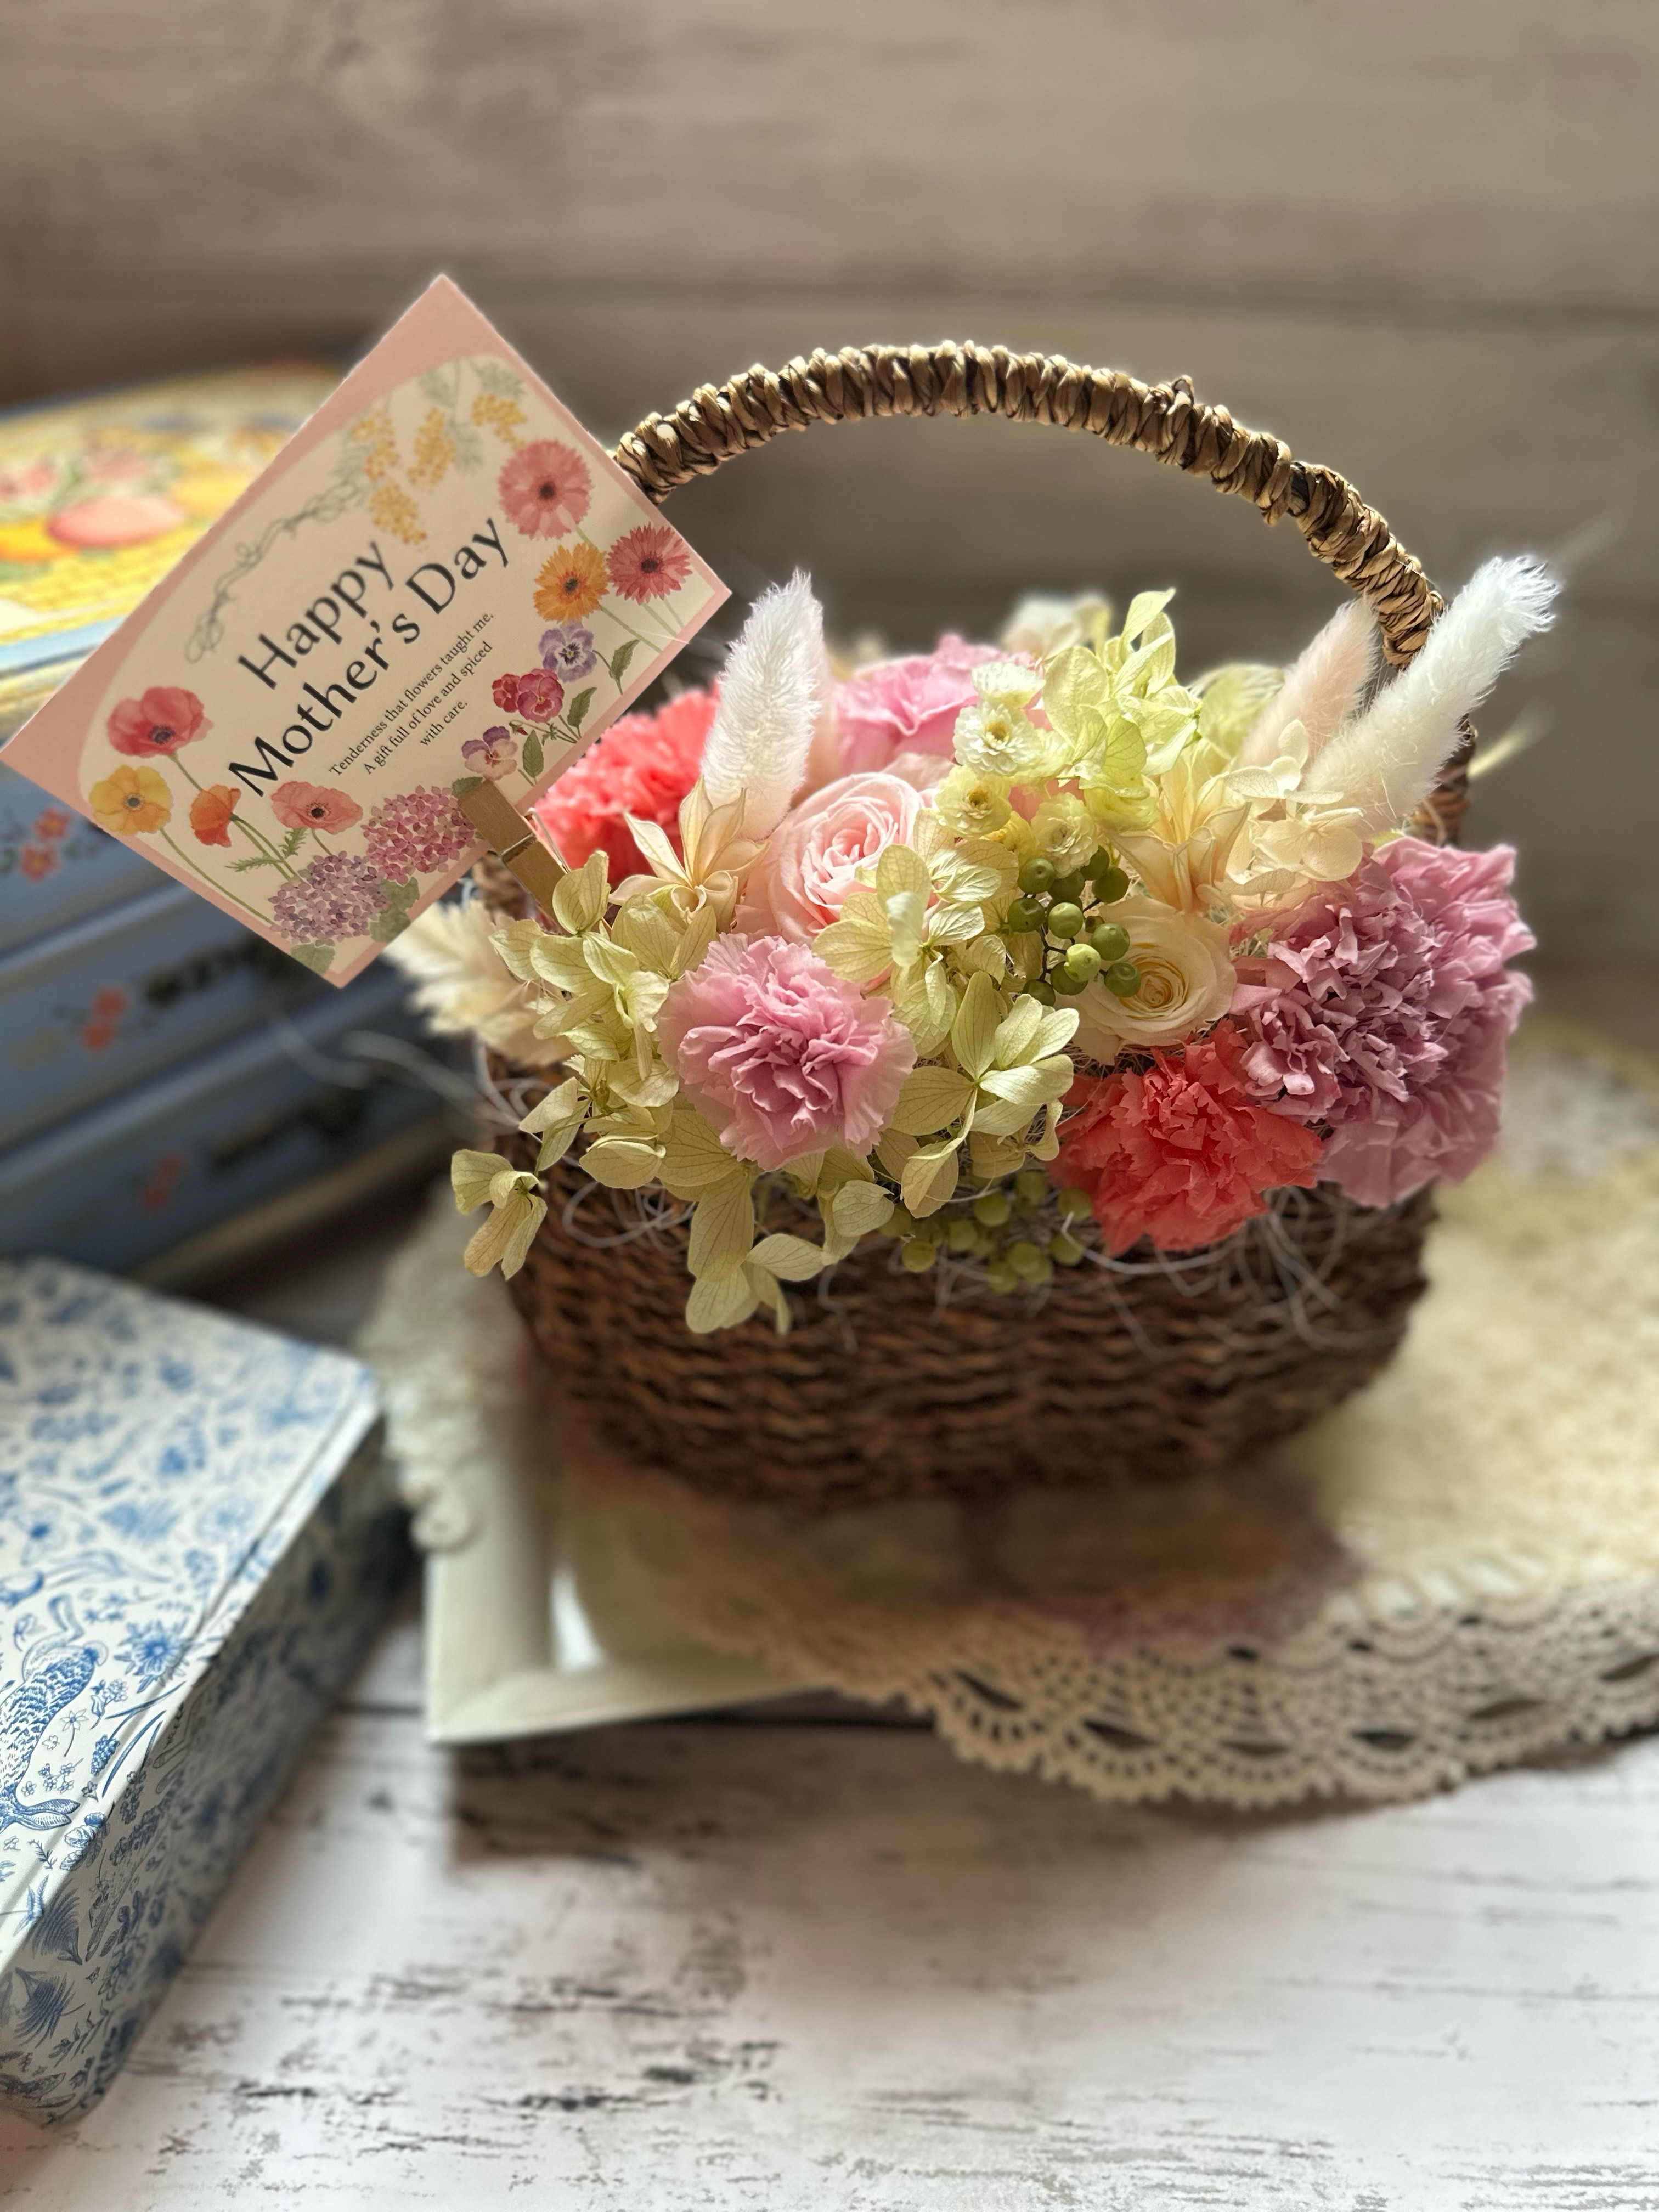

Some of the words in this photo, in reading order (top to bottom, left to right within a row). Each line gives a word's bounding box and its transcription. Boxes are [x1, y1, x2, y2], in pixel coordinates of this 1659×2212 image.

[228, 613, 420, 797] Mother's
[405, 517, 509, 615] Day
[237, 541, 394, 690] Happy
[329, 721, 387, 776] Tenderness
[385, 699, 409, 722] that
[404, 664, 443, 702] flowers
[439, 630, 475, 665] taught
[473, 614, 494, 633] me.
[364, 763, 376, 775] A
[374, 745, 393, 767] gift
[388, 726, 410, 748] full
[408, 713, 422, 729] of
[416, 696, 442, 719] love
[441, 673, 462, 697] and
[460, 640, 493, 676] spiced
[420, 724, 444, 746] with
[443, 702, 468, 724] care.
